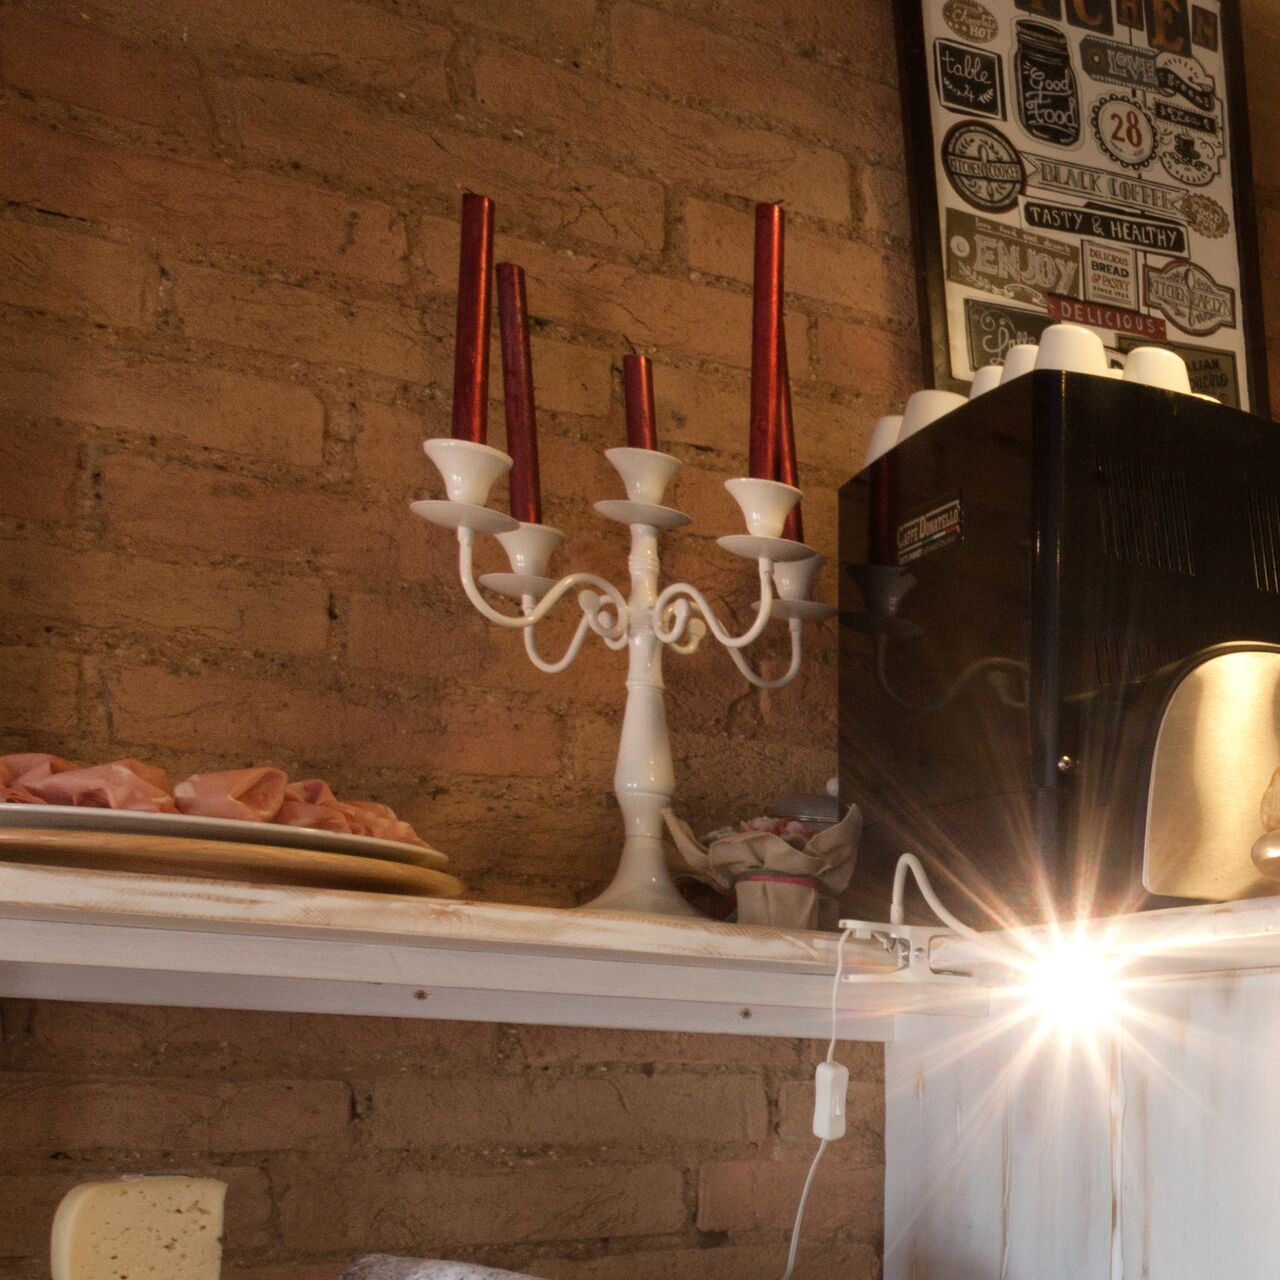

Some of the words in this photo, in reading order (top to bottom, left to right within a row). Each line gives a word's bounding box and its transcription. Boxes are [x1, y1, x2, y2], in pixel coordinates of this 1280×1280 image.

[941, 50, 992, 85] table
[1110, 110, 1143, 148] 28
[1040, 163, 1103, 194] BLACK
[1107, 177, 1174, 210] COFFEE
[1029, 207, 1083, 231] TASTY
[1092, 217, 1105, 236] &
[1110, 221, 1178, 249] HEALTHY
[974, 234, 1078, 296] ENJOY
[1091, 261, 1130, 279] BREAD
[1060, 301, 1157, 334] DELICIOUS
